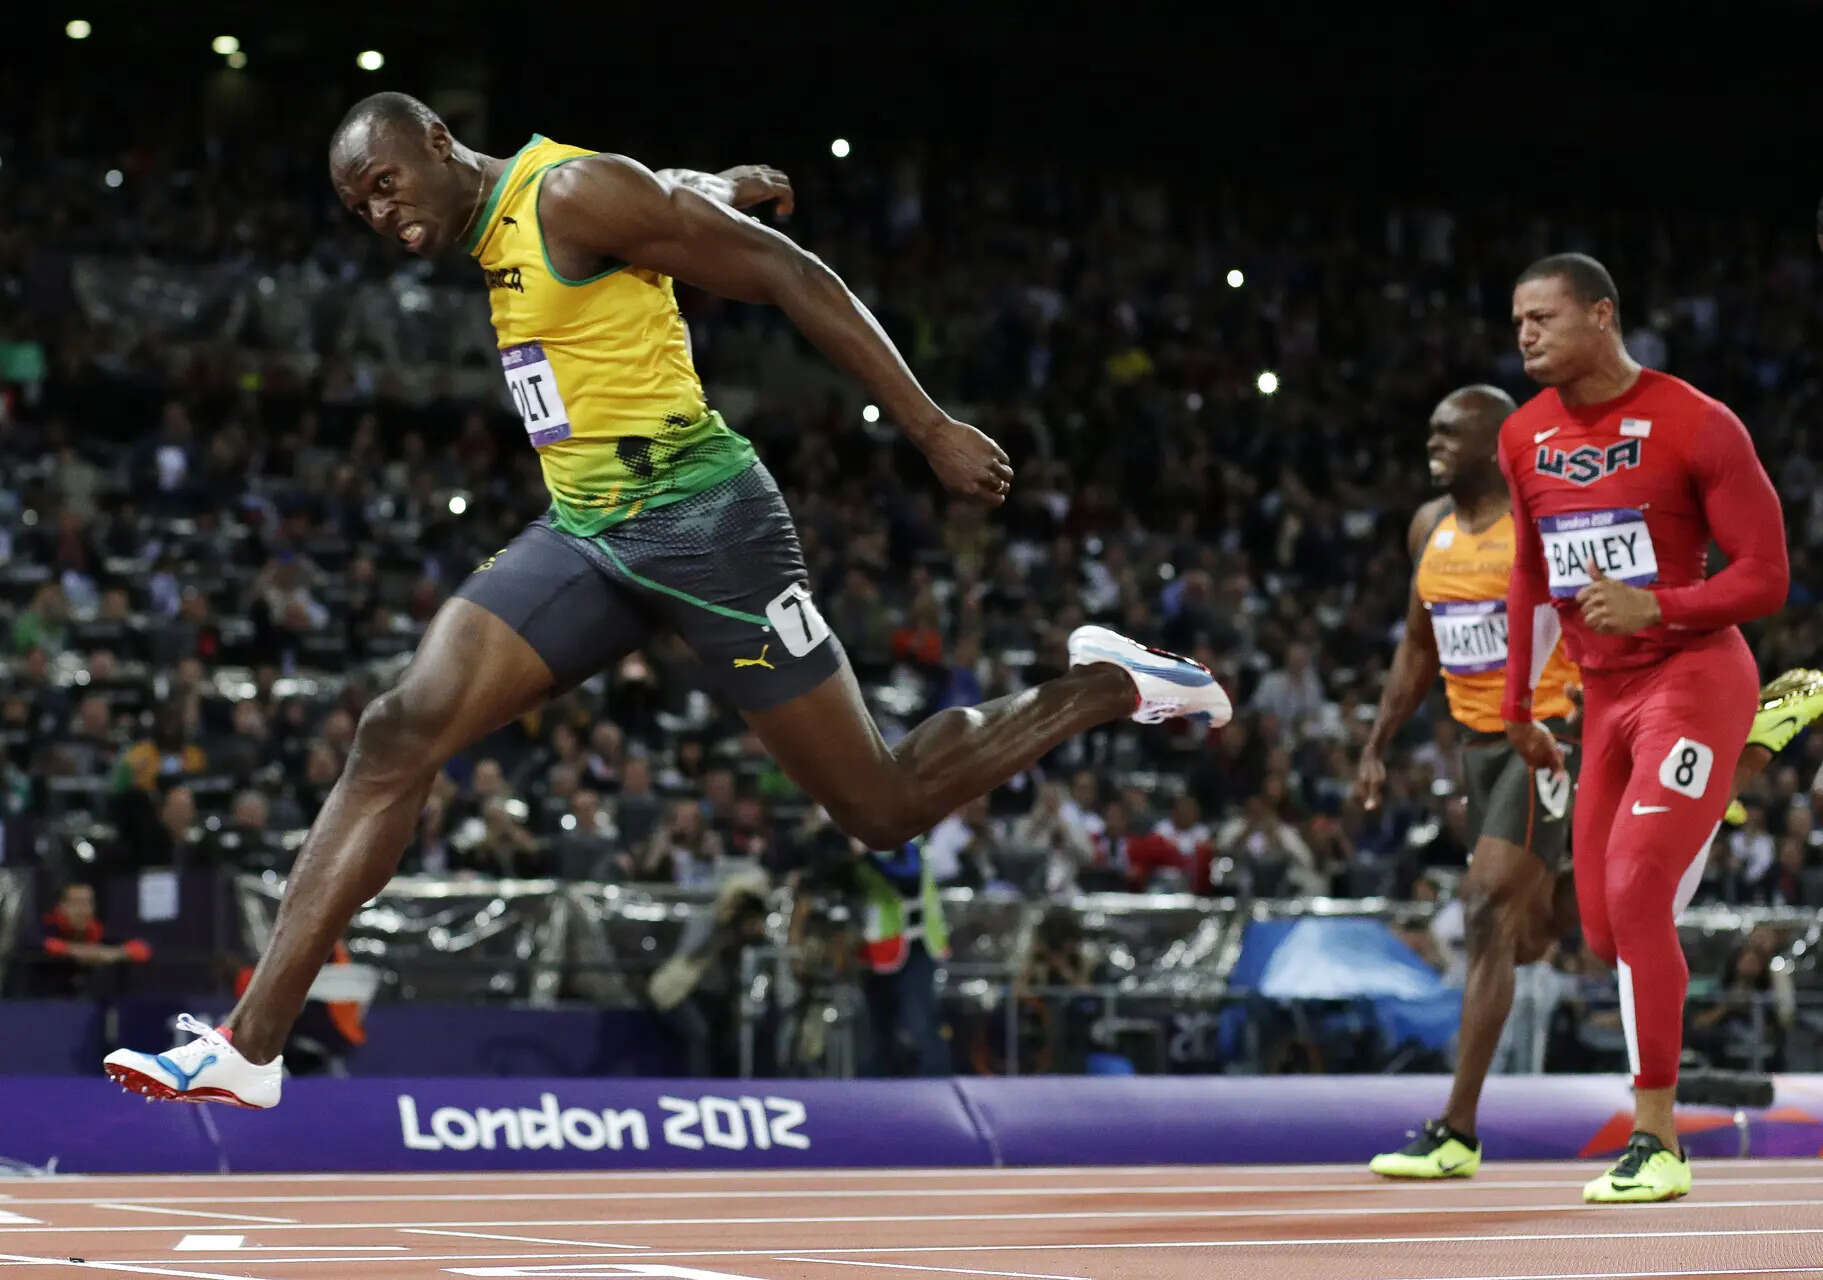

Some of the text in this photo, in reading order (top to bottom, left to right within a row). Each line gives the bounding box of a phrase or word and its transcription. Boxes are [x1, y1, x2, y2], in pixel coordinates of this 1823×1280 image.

[1536, 438, 1642, 487] USA
[780, 594, 813, 644] 7
[1675, 747, 1698, 787] 8
[398, 1094, 811, 1151] London 2012
